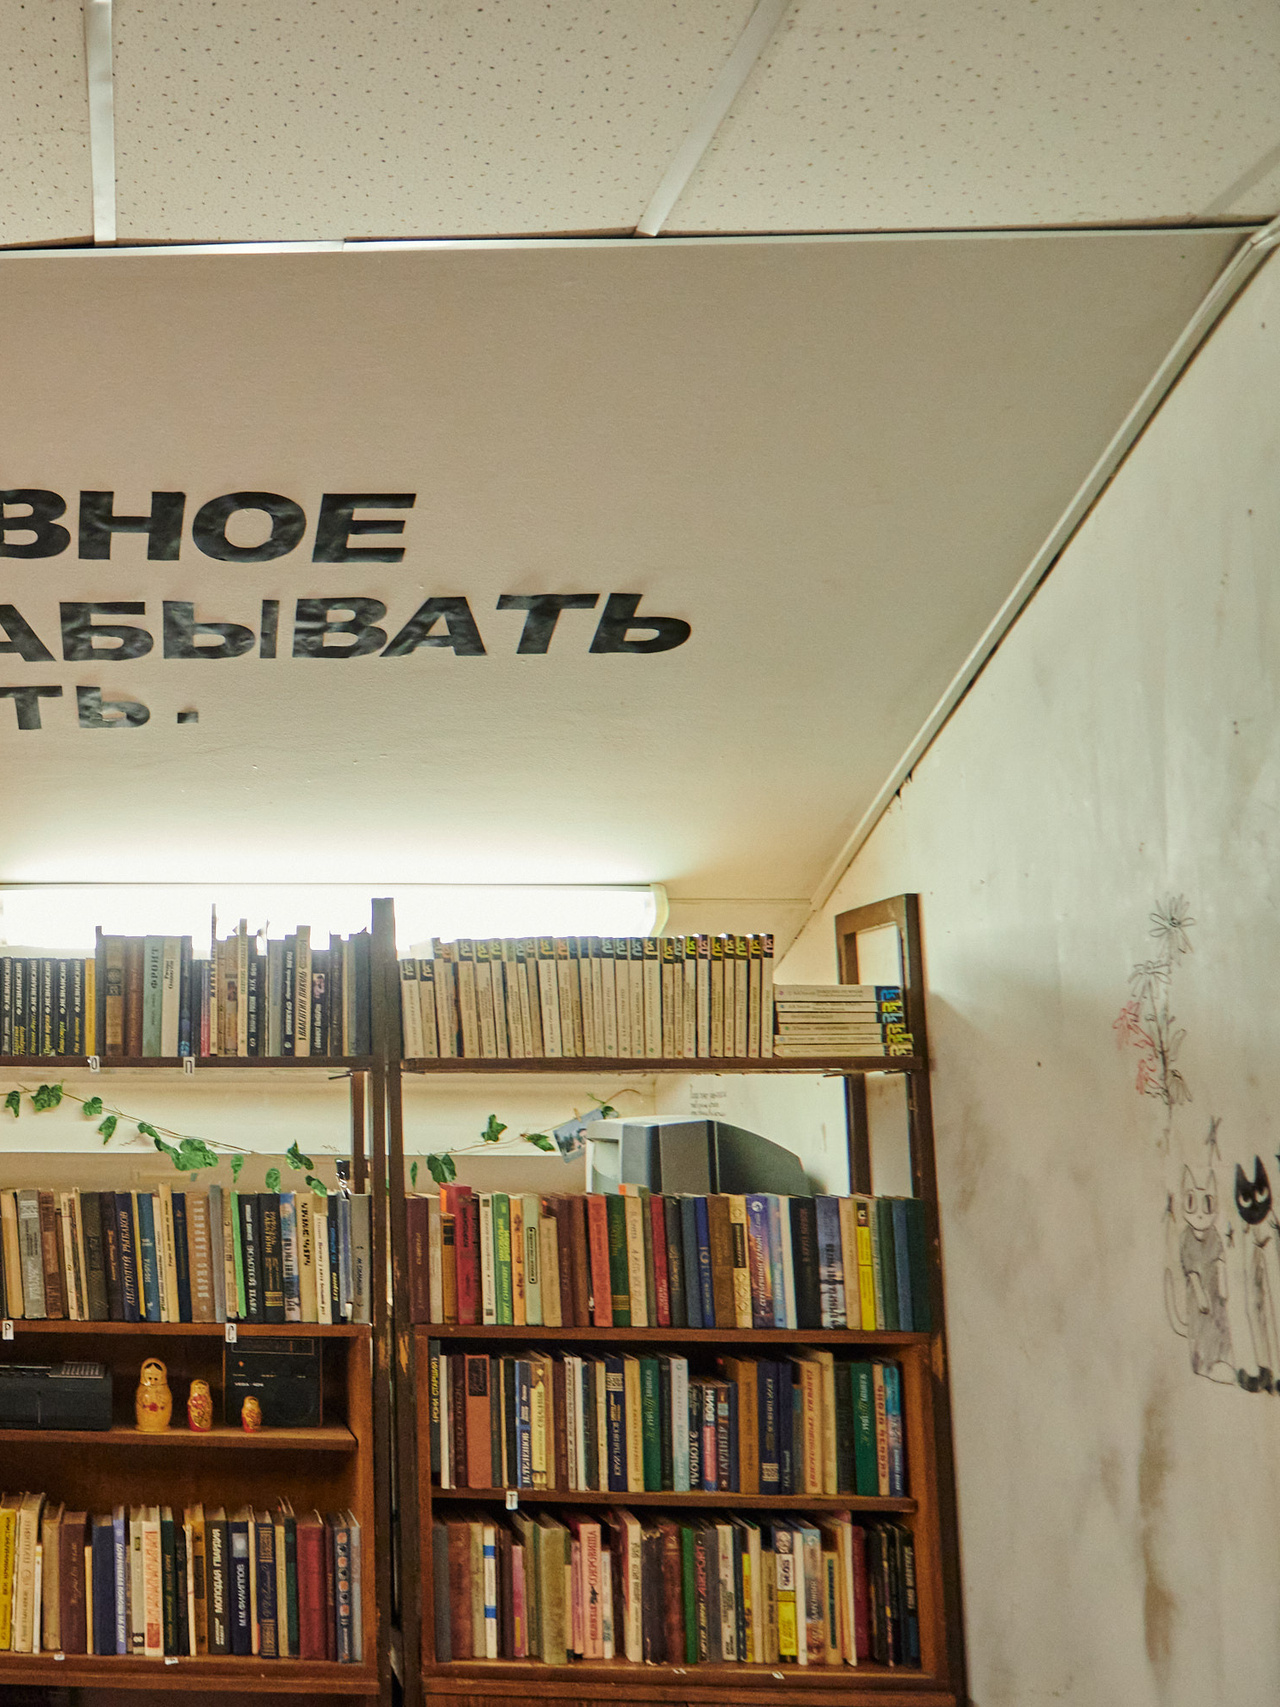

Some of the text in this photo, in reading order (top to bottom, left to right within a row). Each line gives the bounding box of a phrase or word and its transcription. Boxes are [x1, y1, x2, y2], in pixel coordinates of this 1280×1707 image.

[119, 1211, 135, 1307] АНАТОЛИЙ РЫБАКОВ
[718, 1425, 729, 1475] ГАРДНЕР
[211, 1529, 223, 1613] МОЛОДАЯ ГВАРДИЯ
[695, 1544, 707, 1597] AIRPORT
